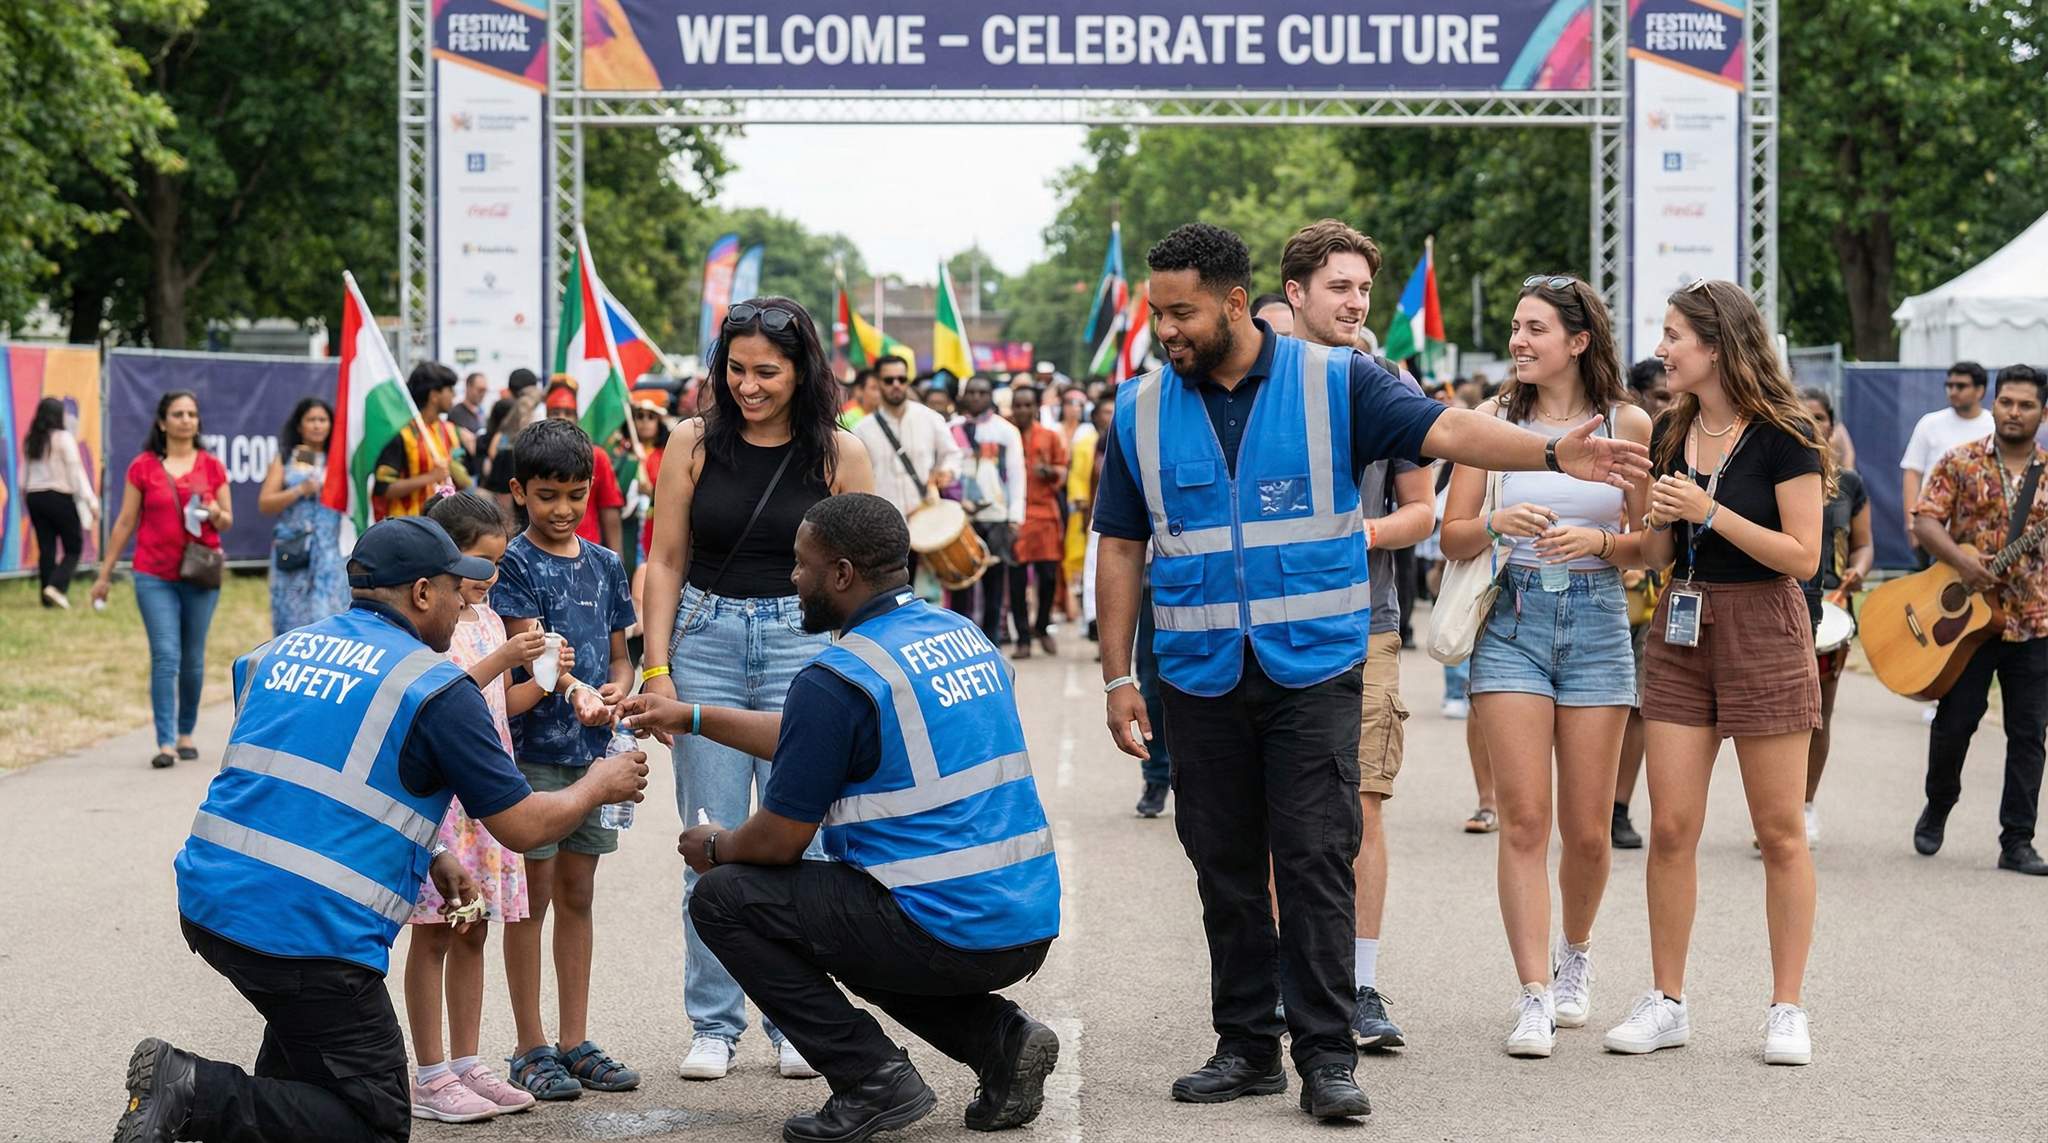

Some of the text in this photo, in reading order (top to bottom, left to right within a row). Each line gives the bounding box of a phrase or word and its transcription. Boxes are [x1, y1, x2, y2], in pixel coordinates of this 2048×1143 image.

[448, 13, 530, 32] FESTIVAL
[448, 33, 531, 52] FESTIVAL
[676, 14, 926, 65] WELCOME
[981, 14, 1265, 65] CELEBRATE
[1277, 14, 1500, 65] CULTURE
[1646, 12, 1727, 32] FESTIVAL
[1646, 31, 1727, 51] FESTIVAL
[275, 632, 387, 676] FESTIVAL
[900, 625, 993, 675] FESTIVAL
[264, 660, 362, 705] SAFETY
[931, 660, 1003, 708] SAFETY
